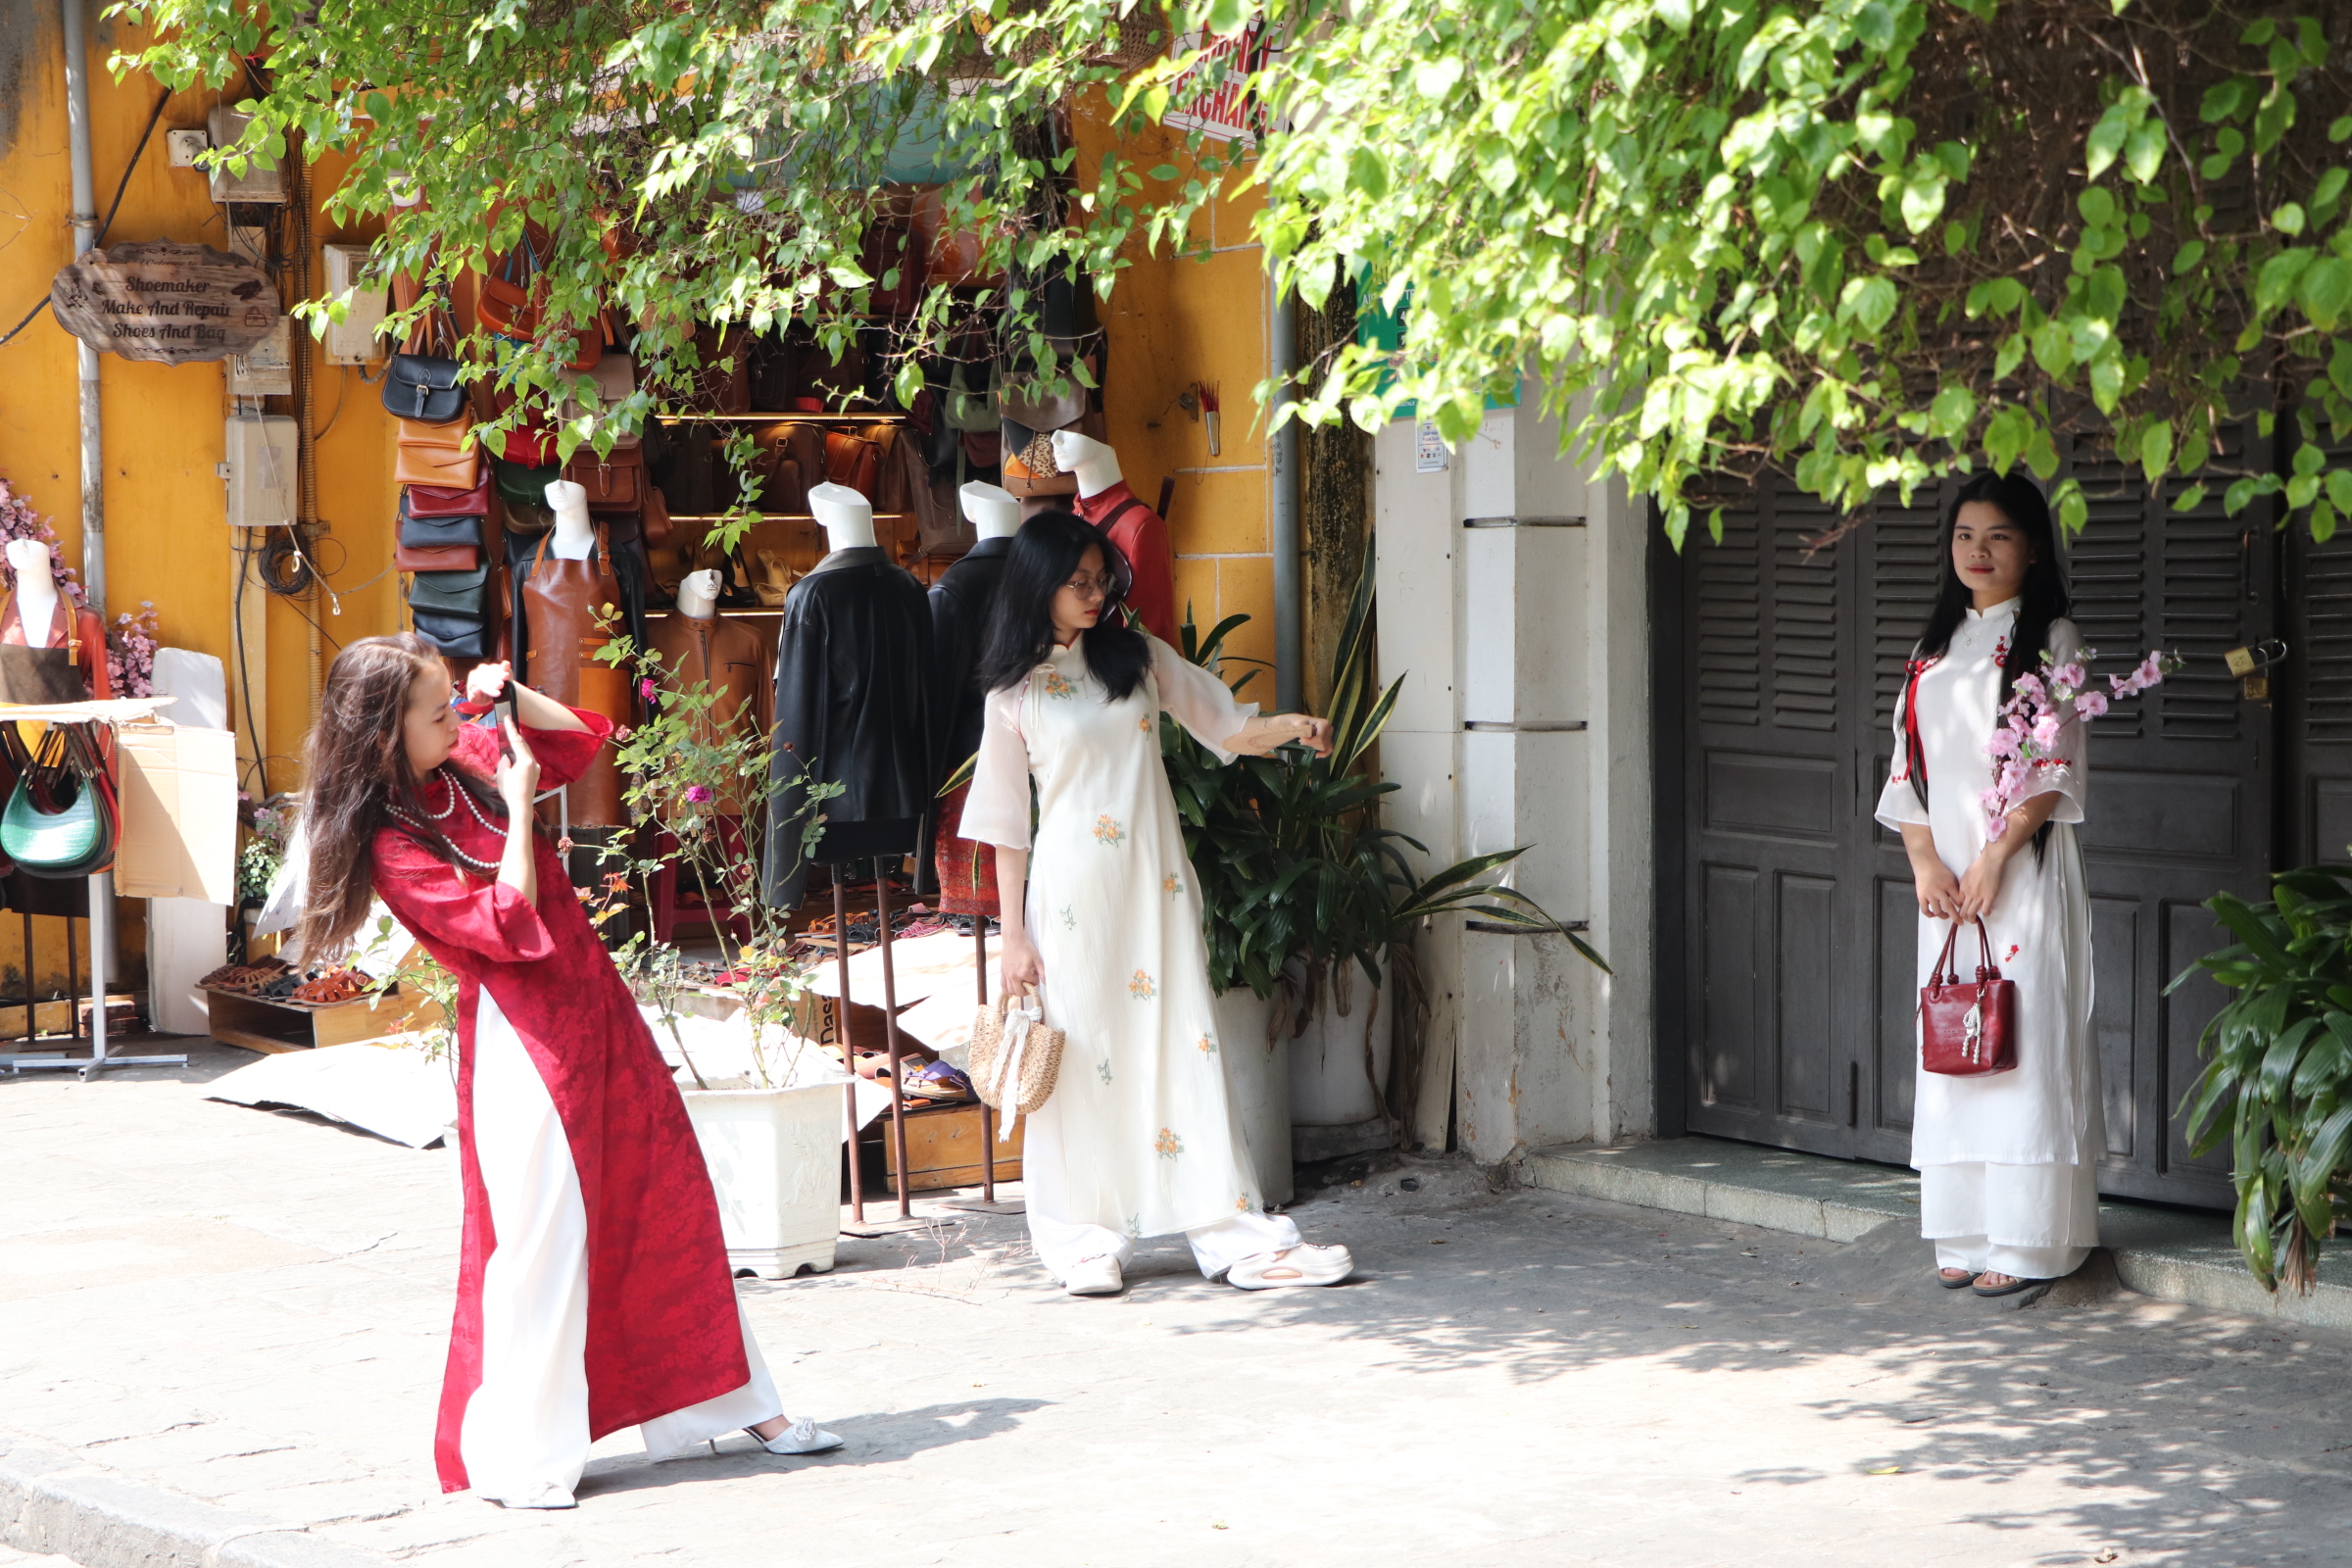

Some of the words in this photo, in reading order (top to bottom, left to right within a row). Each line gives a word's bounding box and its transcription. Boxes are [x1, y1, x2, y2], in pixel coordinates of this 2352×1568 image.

[125, 276, 211, 293] Shoemaker
[102, 300, 143, 316] Make
[147, 300, 180, 317] And
[183, 301, 230, 319] Repair
[113, 322, 156, 339] Shoes
[159, 323, 191, 340] And
[194, 324, 226, 343] Bag
